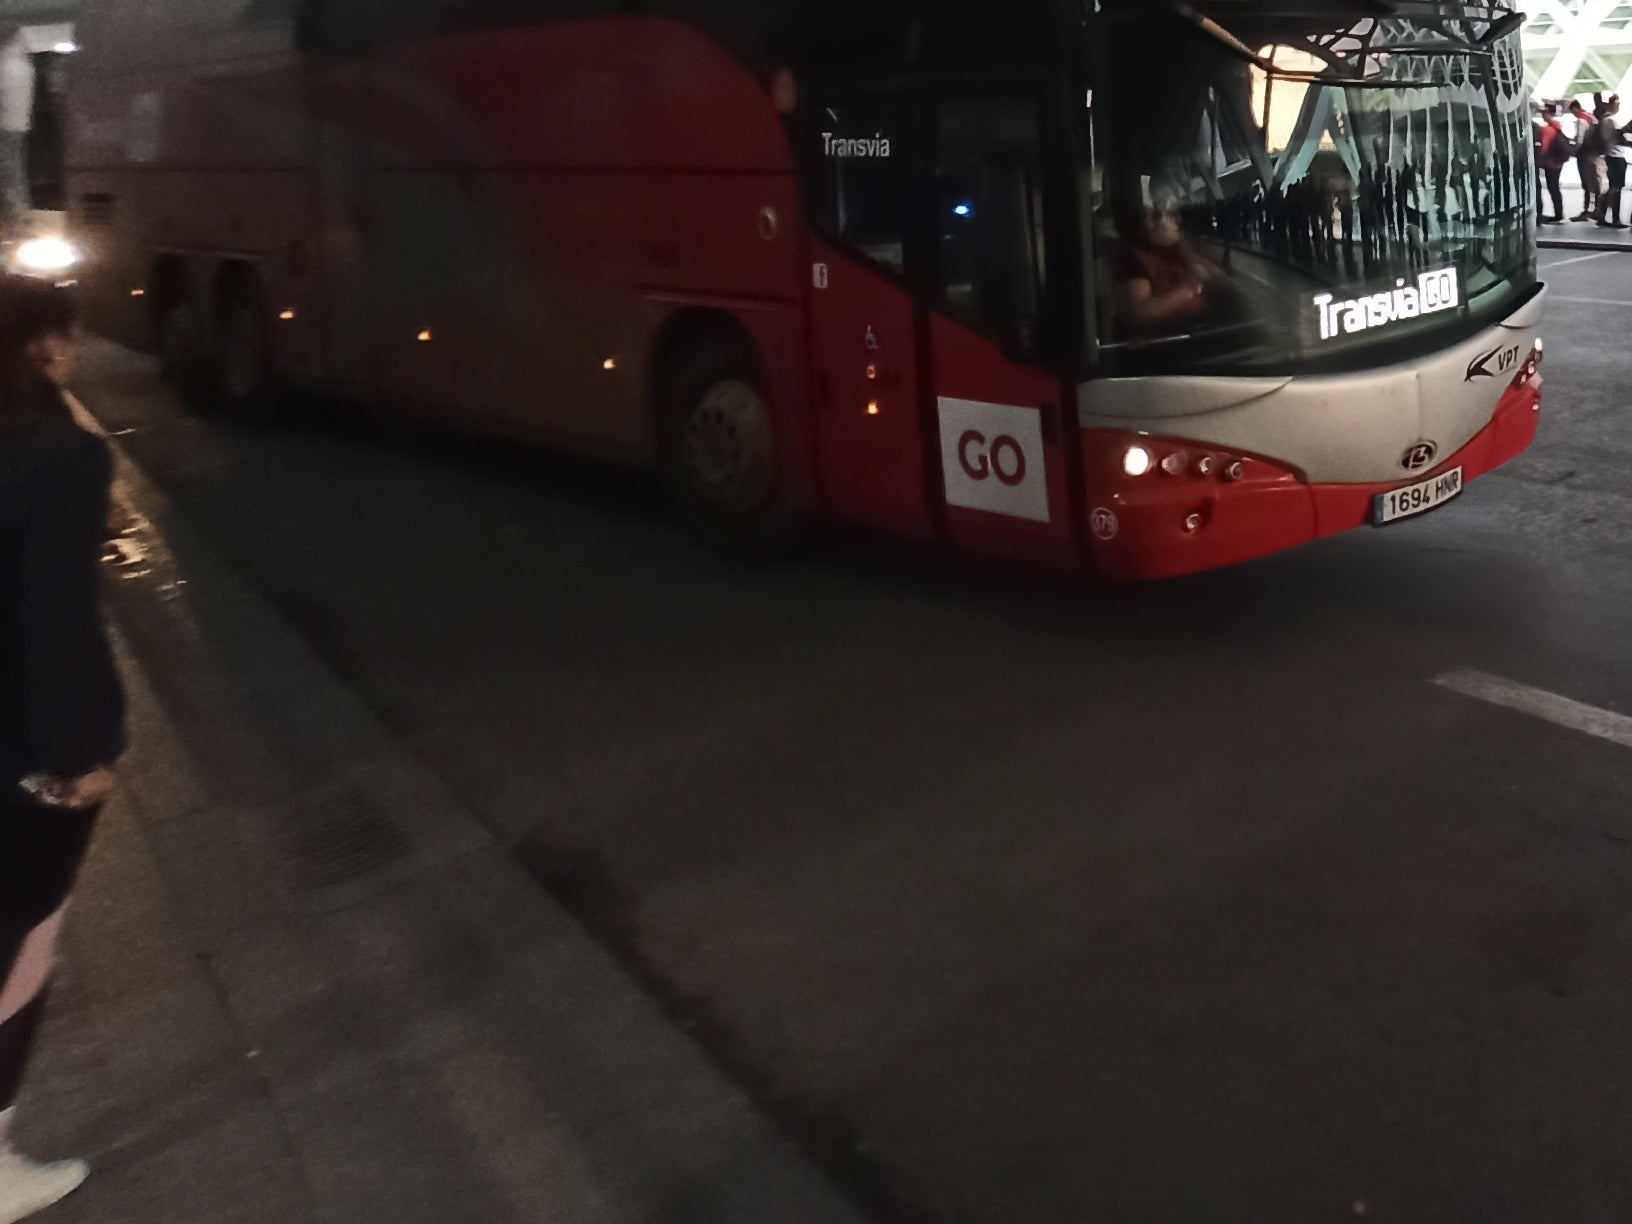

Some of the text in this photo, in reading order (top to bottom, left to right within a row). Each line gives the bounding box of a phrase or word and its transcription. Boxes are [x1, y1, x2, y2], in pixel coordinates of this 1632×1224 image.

[820, 132, 891, 158] Transvia
[1498, 345, 1520, 371] VPT
[958, 429, 1026, 487] GO
[1389, 483, 1431, 515] 1694
